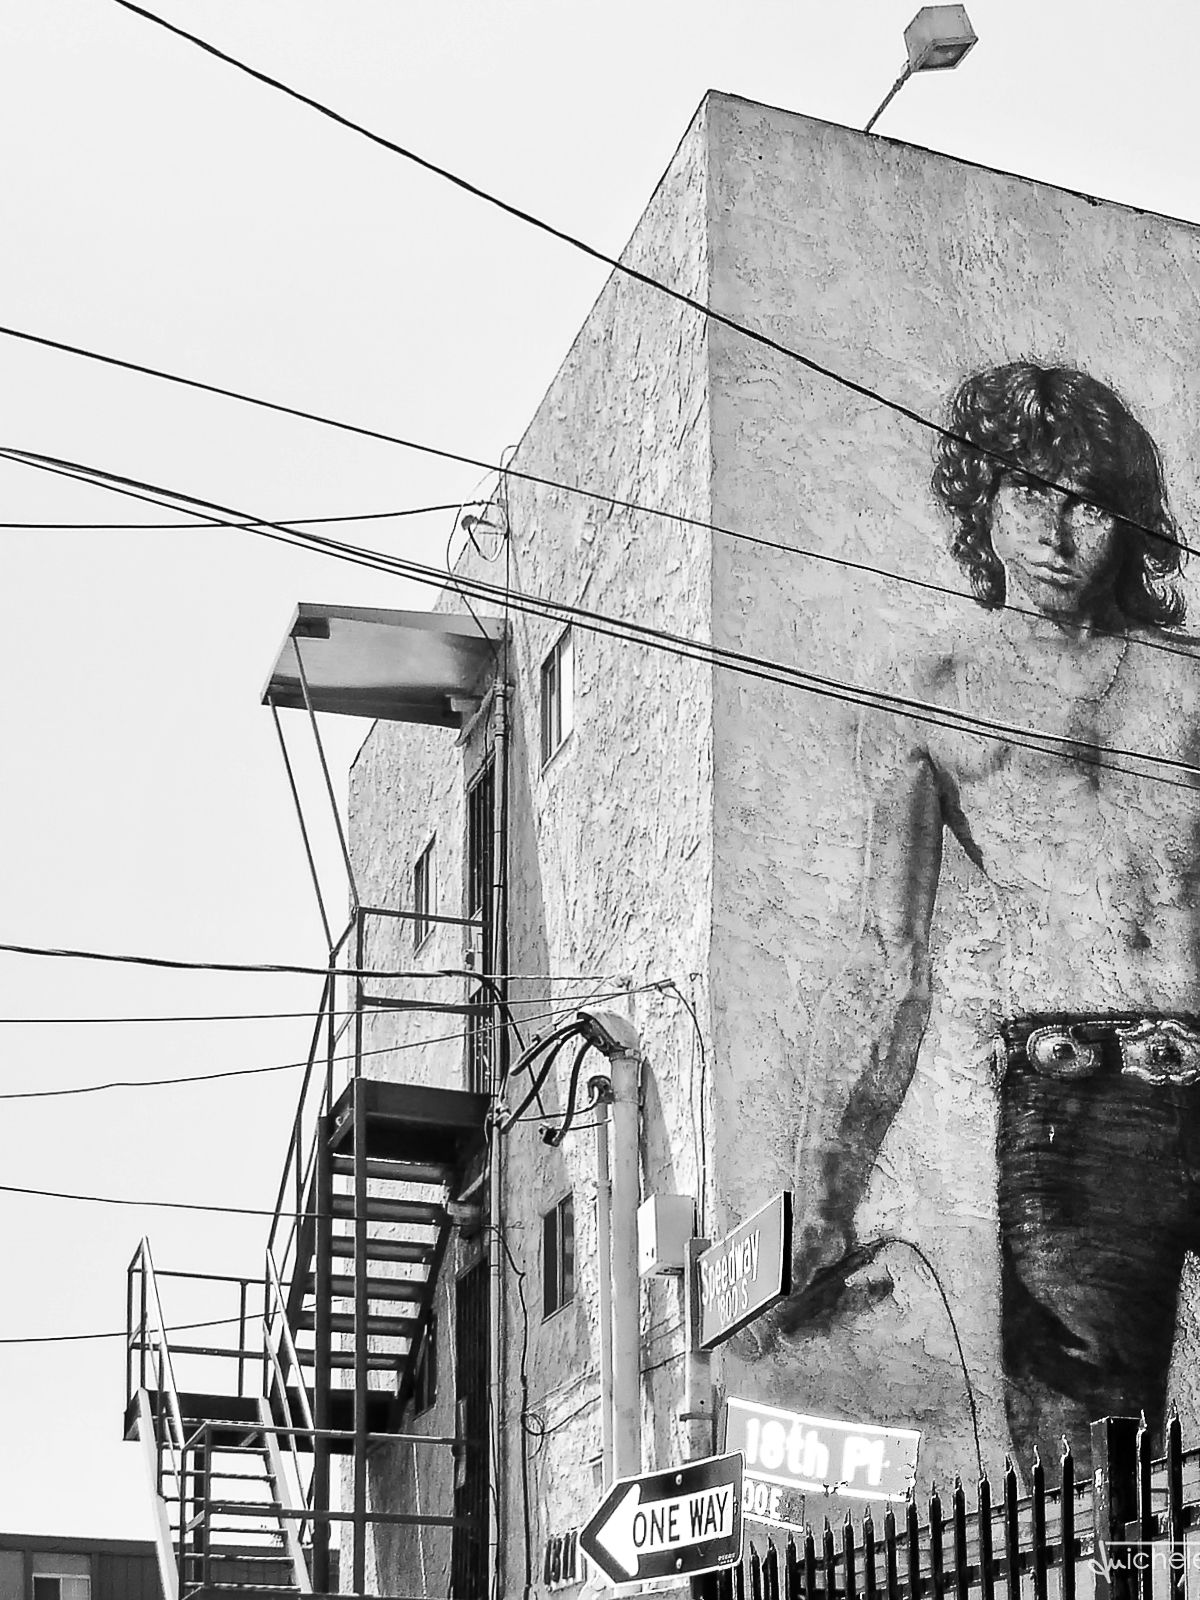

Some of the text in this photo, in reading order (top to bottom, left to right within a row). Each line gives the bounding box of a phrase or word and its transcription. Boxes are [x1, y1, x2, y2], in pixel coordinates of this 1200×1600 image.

[701, 1229, 760, 1312] Speedway
[742, 1278, 749, 1310] S
[746, 1417, 830, 1479] 18th
[633, 1491, 728, 1548] ONE WAY
